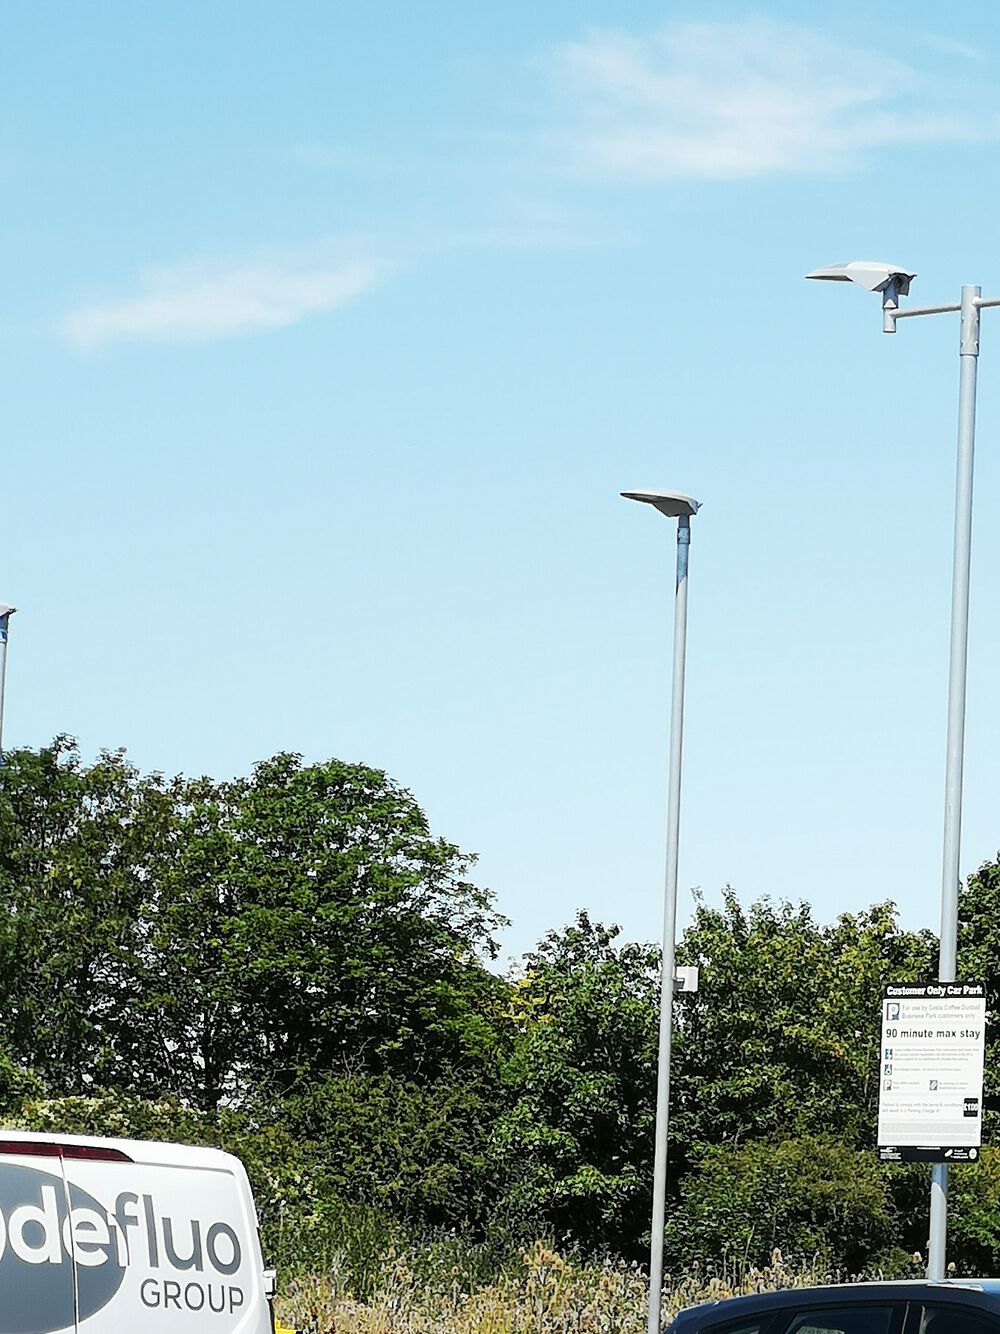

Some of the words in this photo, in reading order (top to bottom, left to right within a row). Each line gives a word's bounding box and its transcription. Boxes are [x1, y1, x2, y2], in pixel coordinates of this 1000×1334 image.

[886, 985, 926, 996] Customer
[926, 985, 946, 997] Only
[947, 985, 962, 995] Car
[963, 985, 983, 995] Park
[886, 1028, 898, 1038] 90
[900, 1028, 934, 1038] minute
[936, 1030, 957, 1038] max
[959, 1030, 981, 1040] stay
[0, 1184, 242, 1277] defluo
[140, 1278, 244, 1314] GROUP
